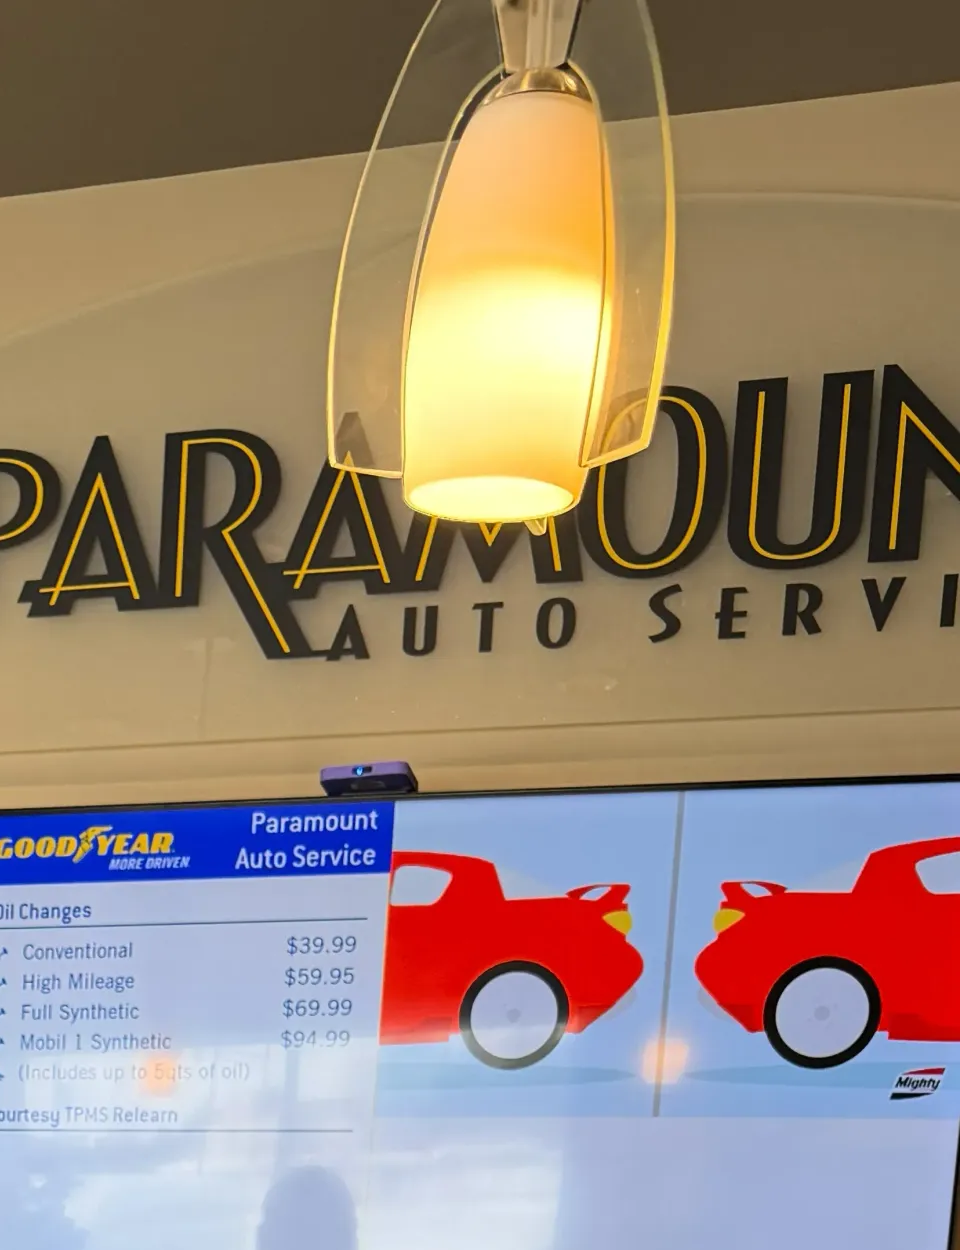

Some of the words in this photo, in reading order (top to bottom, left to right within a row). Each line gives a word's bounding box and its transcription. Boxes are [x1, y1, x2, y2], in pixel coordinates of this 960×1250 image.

[325, 597, 577, 661] AUTO
[648, 573, 959, 644] SERVI
[251, 811, 378, 834] Paramount
[108, 857, 142, 870] MORE
[145, 856, 190, 869] DRIVEN
[235, 848, 287, 871] Auto
[292, 845, 376, 868] Service
[19, 903, 92, 924] Changes
[23, 943, 133, 961] Conventional
[286, 936, 357, 956] $39.99
[22, 974, 61, 993] High
[68, 973, 134, 992] Mileage
[284, 967, 355, 987] $59.95
[21, 1004, 52, 1022] Full
[59, 1004, 140, 1024] Synthetic
[283, 999, 353, 1019] $69.99
[20, 1034, 66, 1052] Mobil
[75, 1034, 82, 1051] 1
[91, 1033, 172, 1054] Synthetic
[280, 1030, 351, 1050] $94.99
[18, 1063, 97, 1082] (Includes
[103, 1067, 124, 1085] up
[131, 1066, 147, 1081] to
[198, 1062, 217, 1080] of
[221, 1062, 251, 1082] oil)
[894, 1077, 941, 1091] Mighty
[64, 1107, 109, 1123] TPMS
[113, 1107, 178, 1124] Relearn
